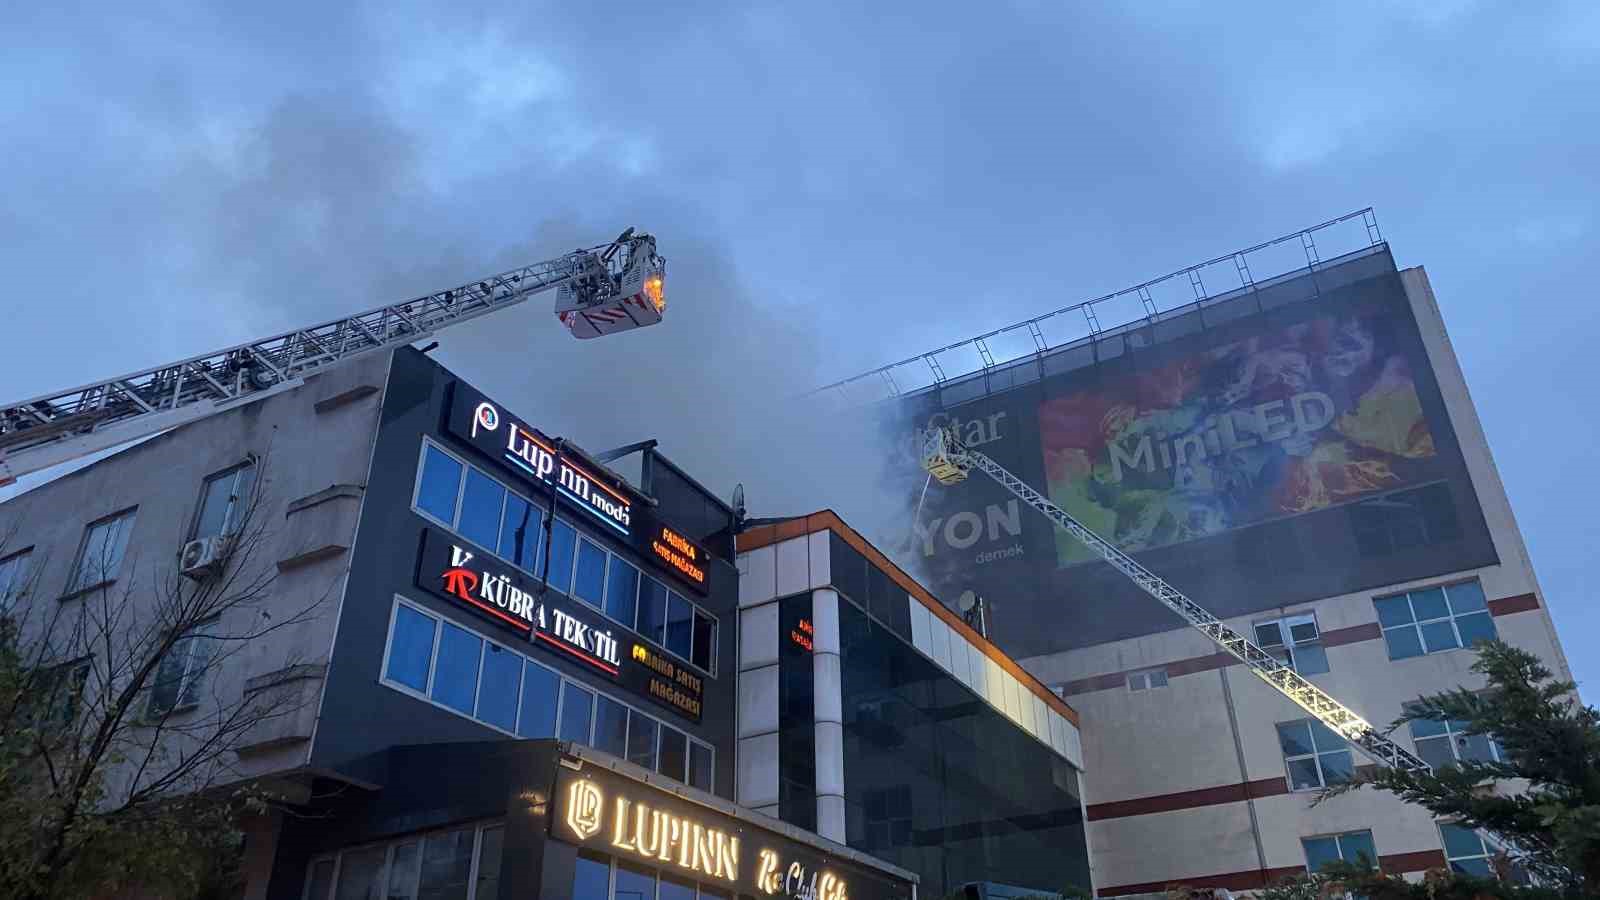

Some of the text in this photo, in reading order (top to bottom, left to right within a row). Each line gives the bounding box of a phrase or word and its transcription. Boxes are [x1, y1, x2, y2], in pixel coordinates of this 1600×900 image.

[506, 422, 589, 501] Lupnn
[1107, 390, 1336, 484] MiniLED
[975, 543, 1024, 565] demek
[553, 608, 621, 666] TEKSTİL
[612, 797, 739, 881] LUPINN
